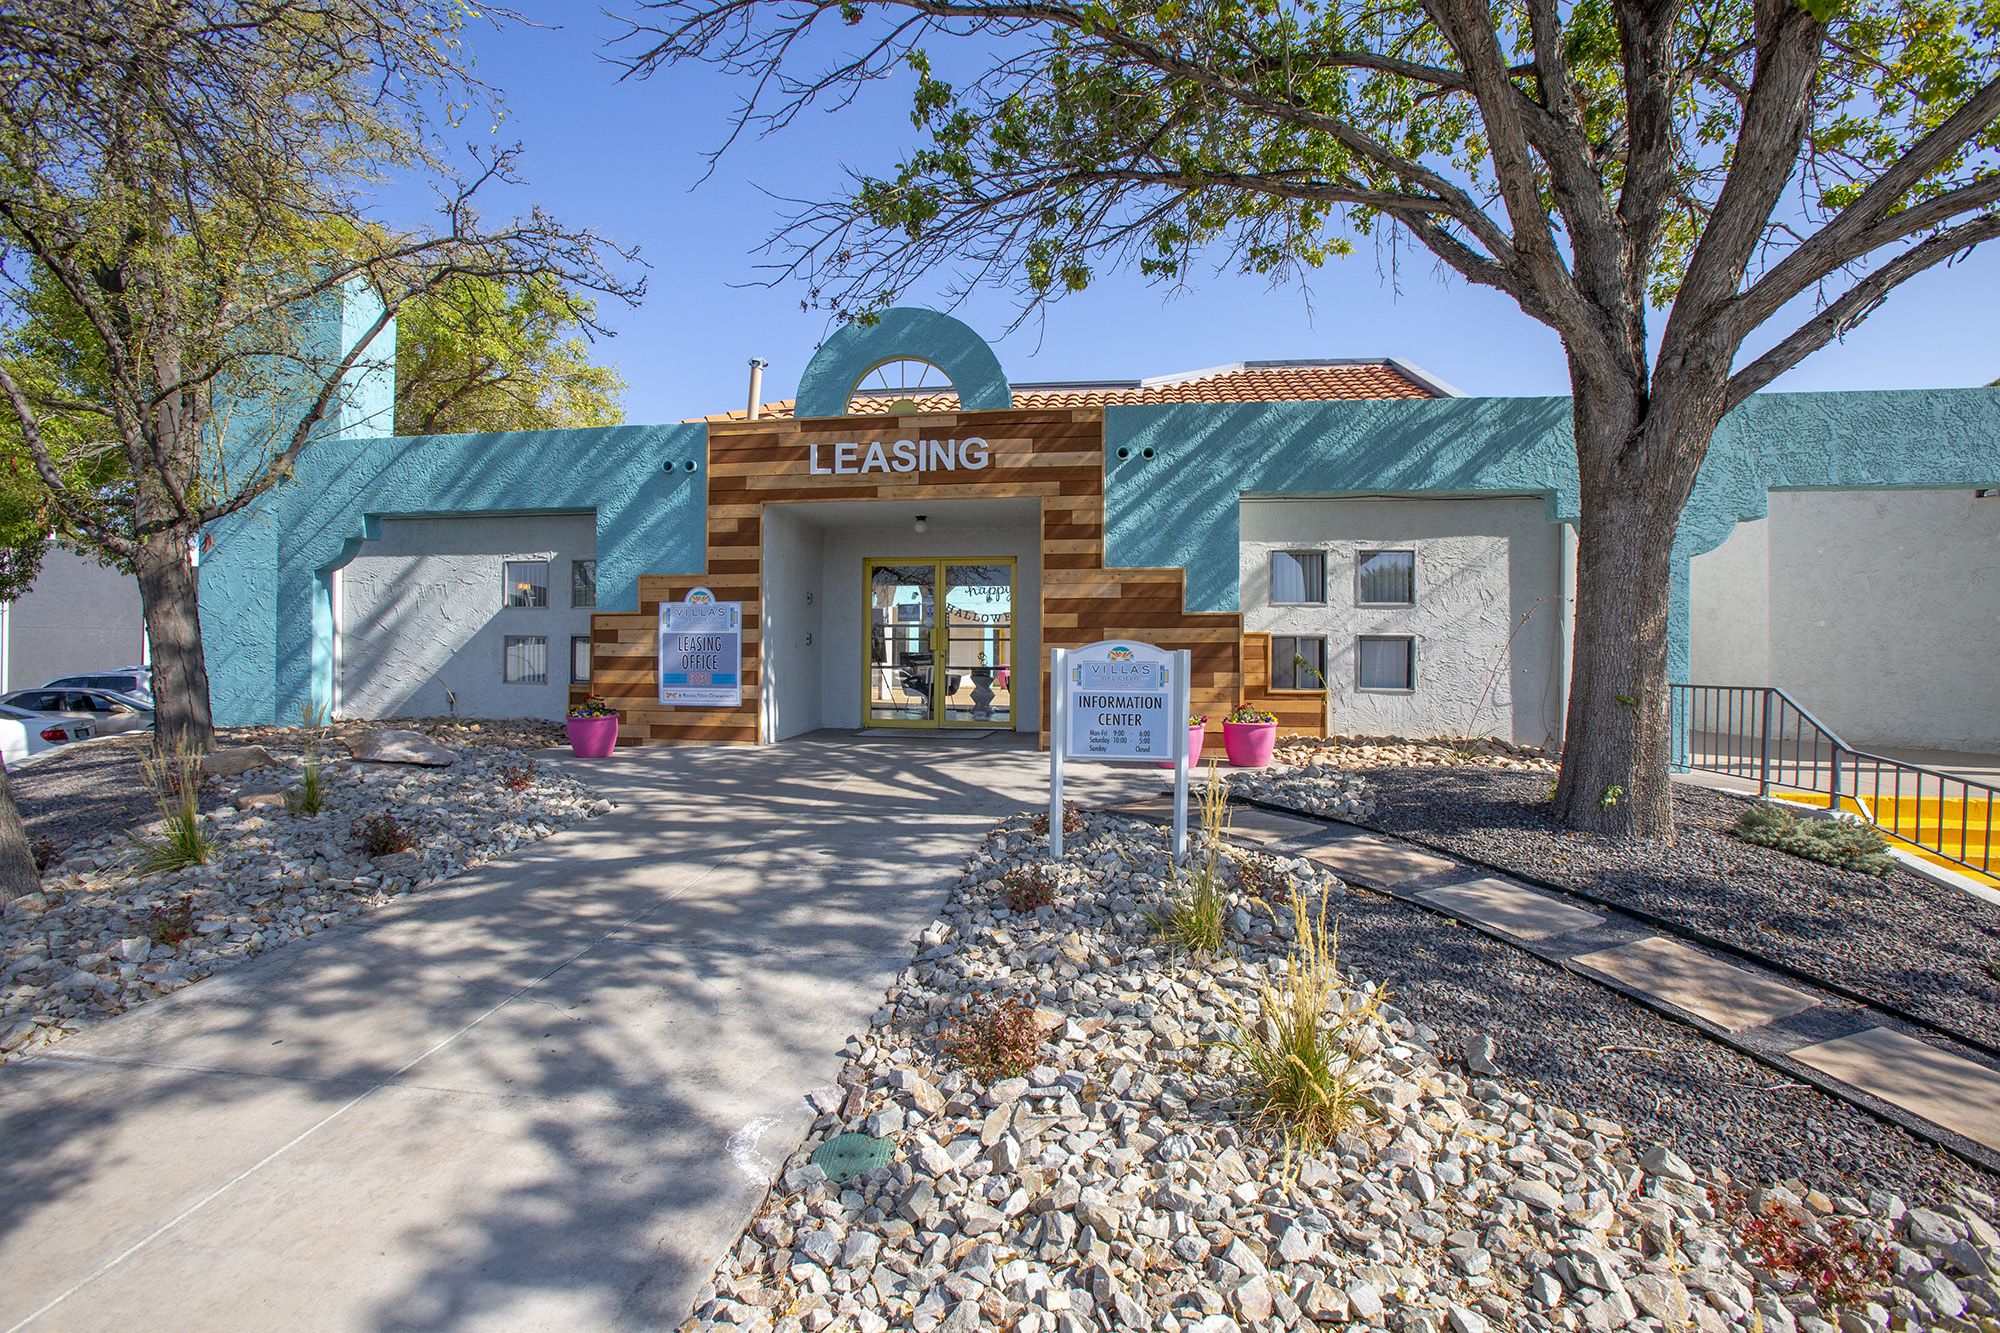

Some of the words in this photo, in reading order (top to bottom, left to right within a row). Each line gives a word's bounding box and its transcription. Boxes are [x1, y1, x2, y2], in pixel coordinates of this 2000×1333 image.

[809, 437, 989, 475] LEASING
[675, 608, 726, 617] VILLAS
[678, 636, 722, 652] LEASING
[682, 655, 718, 670] OFFICE
[1091, 665, 1151, 675] VILLAS
[1079, 696, 1162, 709] INFORMATION
[1098, 713, 1142, 726] CENTER
[1089, 745, 1107, 753] Sunday
